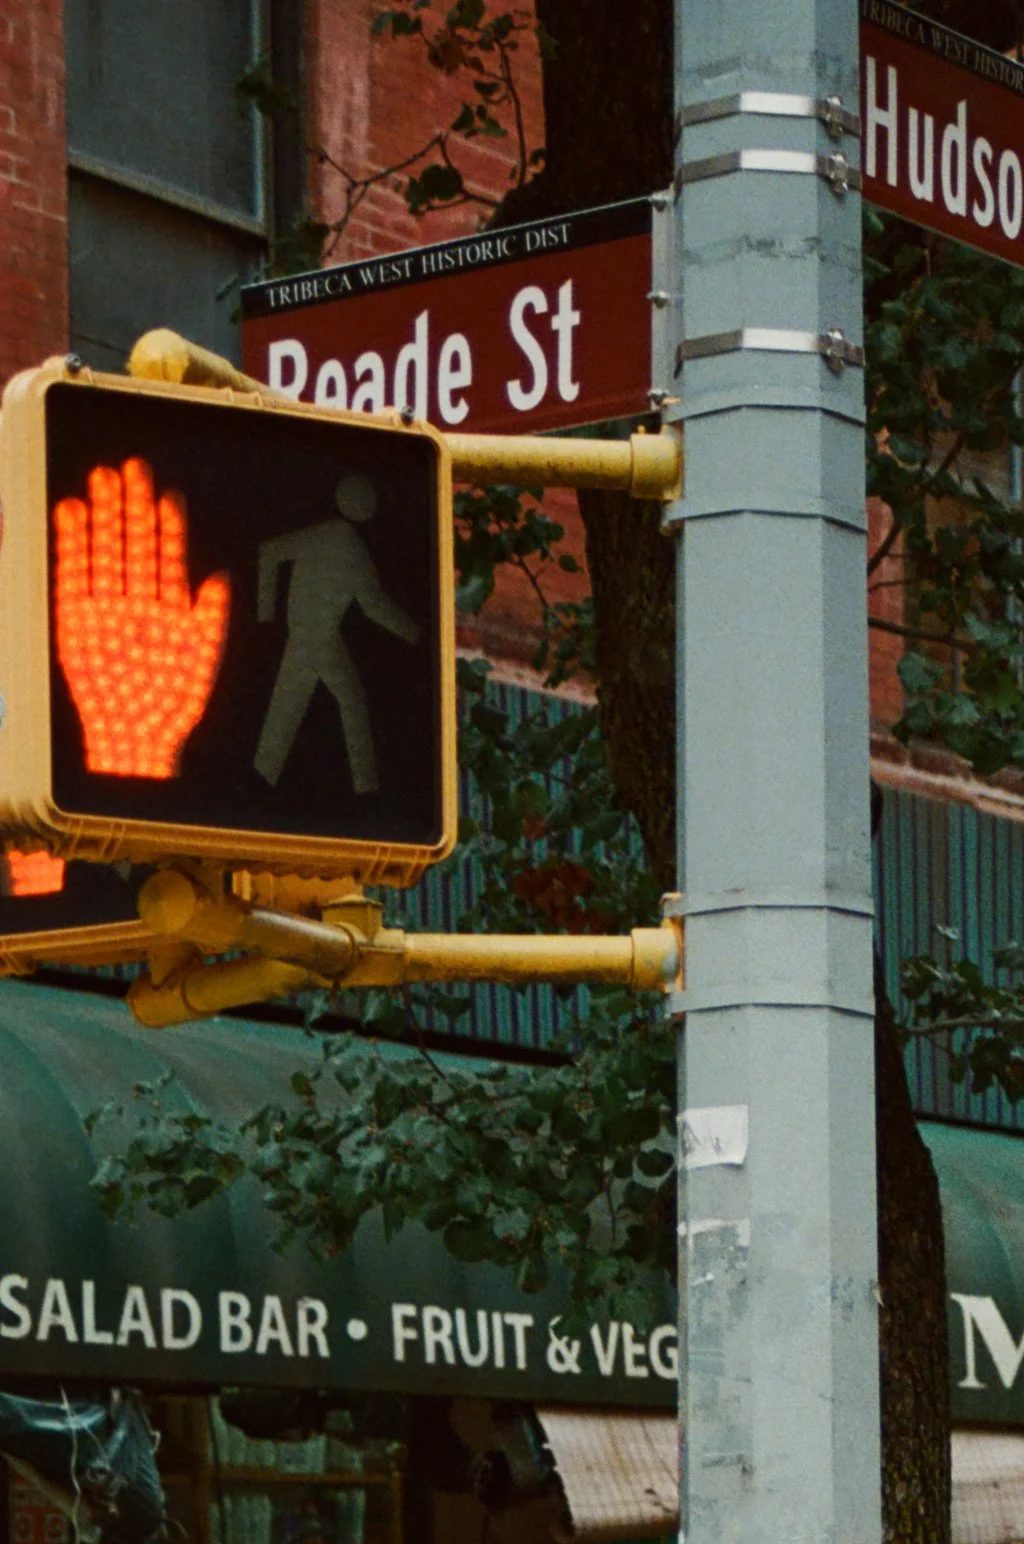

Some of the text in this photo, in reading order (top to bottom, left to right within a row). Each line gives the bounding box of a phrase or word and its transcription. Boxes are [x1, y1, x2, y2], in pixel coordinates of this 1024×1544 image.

[862, 1, 925, 45] TRIBECA
[932, 27, 969, 64] WEST
[266, 222, 572, 308] TRIBECA WEST HISTORIC DIST
[268, 278, 581, 425] Reade St
[0, 1273, 202, 1350] SALAD
[218, 1290, 331, 1358] BAR
[392, 1304, 533, 1369] FRUIT
[546, 1315, 582, 1374] &
